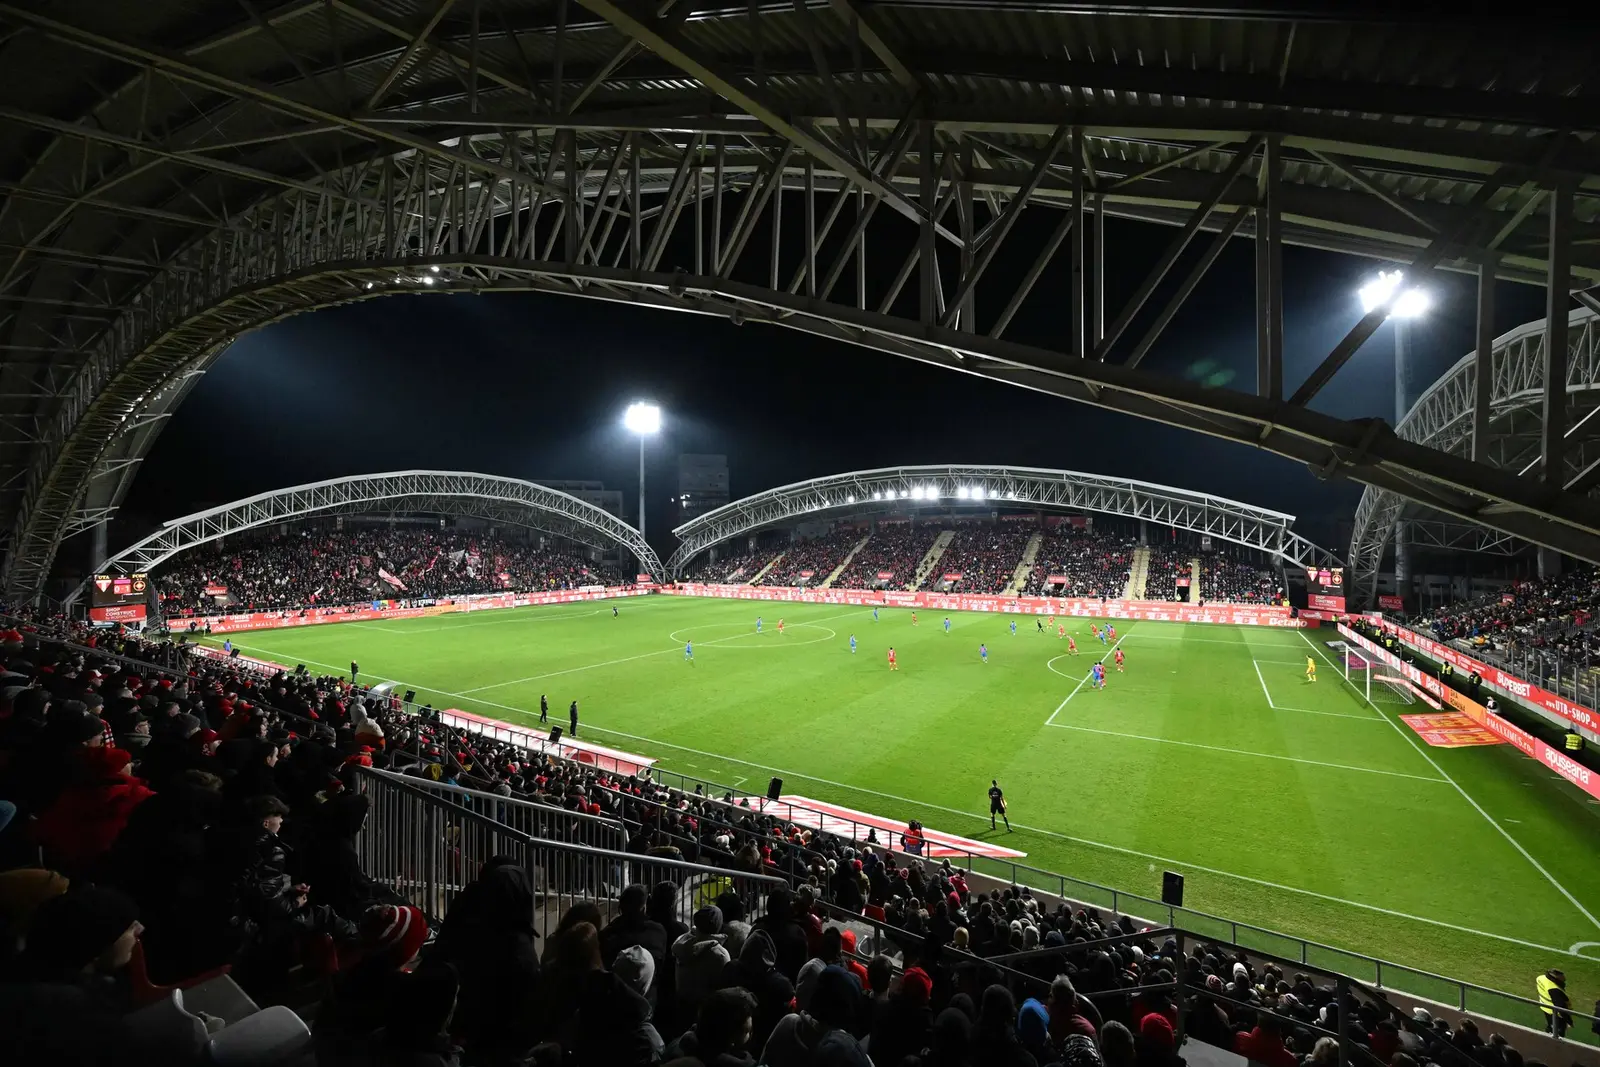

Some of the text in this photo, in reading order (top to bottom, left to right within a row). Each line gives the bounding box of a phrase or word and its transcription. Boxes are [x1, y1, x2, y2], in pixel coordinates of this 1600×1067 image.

[1269, 617, 1308, 627] Betano
[1496, 671, 1530, 697] SUPERBET
[1545, 747, 1589, 785] apuseana
